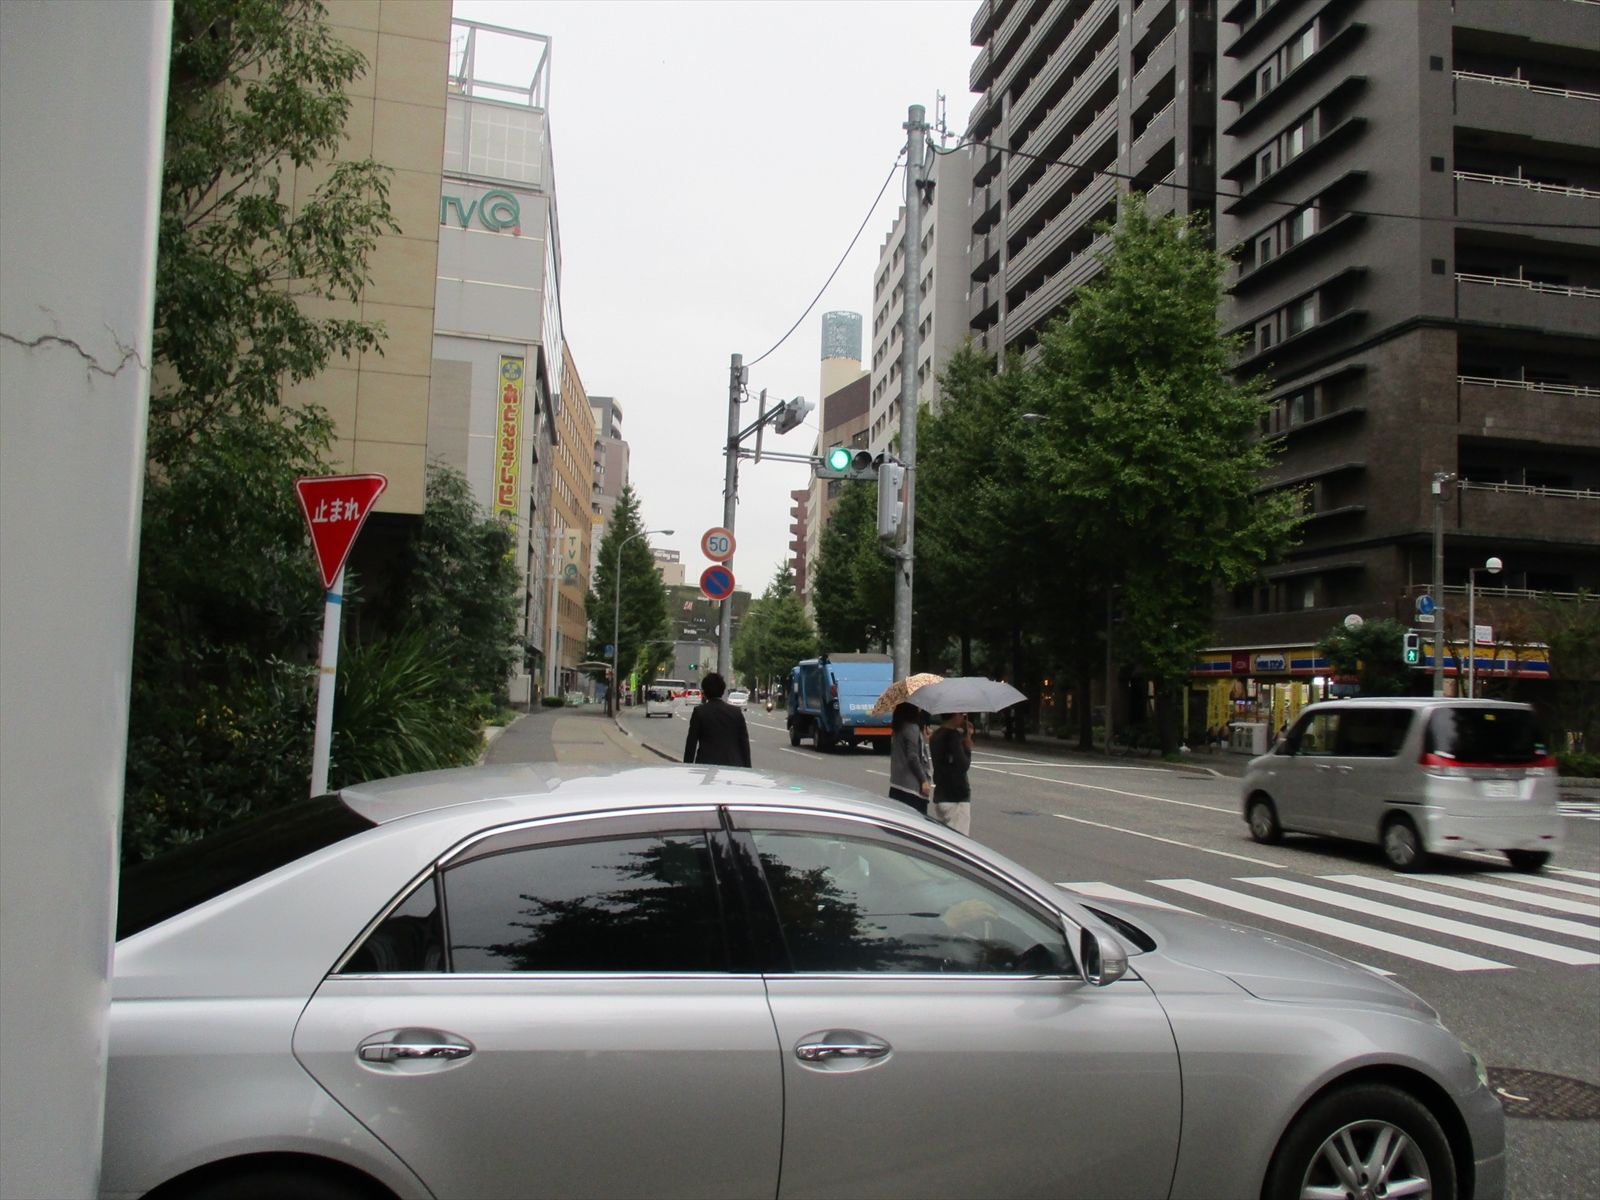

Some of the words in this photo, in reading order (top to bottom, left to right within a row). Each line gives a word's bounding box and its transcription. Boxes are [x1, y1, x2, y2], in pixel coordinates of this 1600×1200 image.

[311, 497, 360, 523] 止まれ
[709, 536, 729, 553] 50
